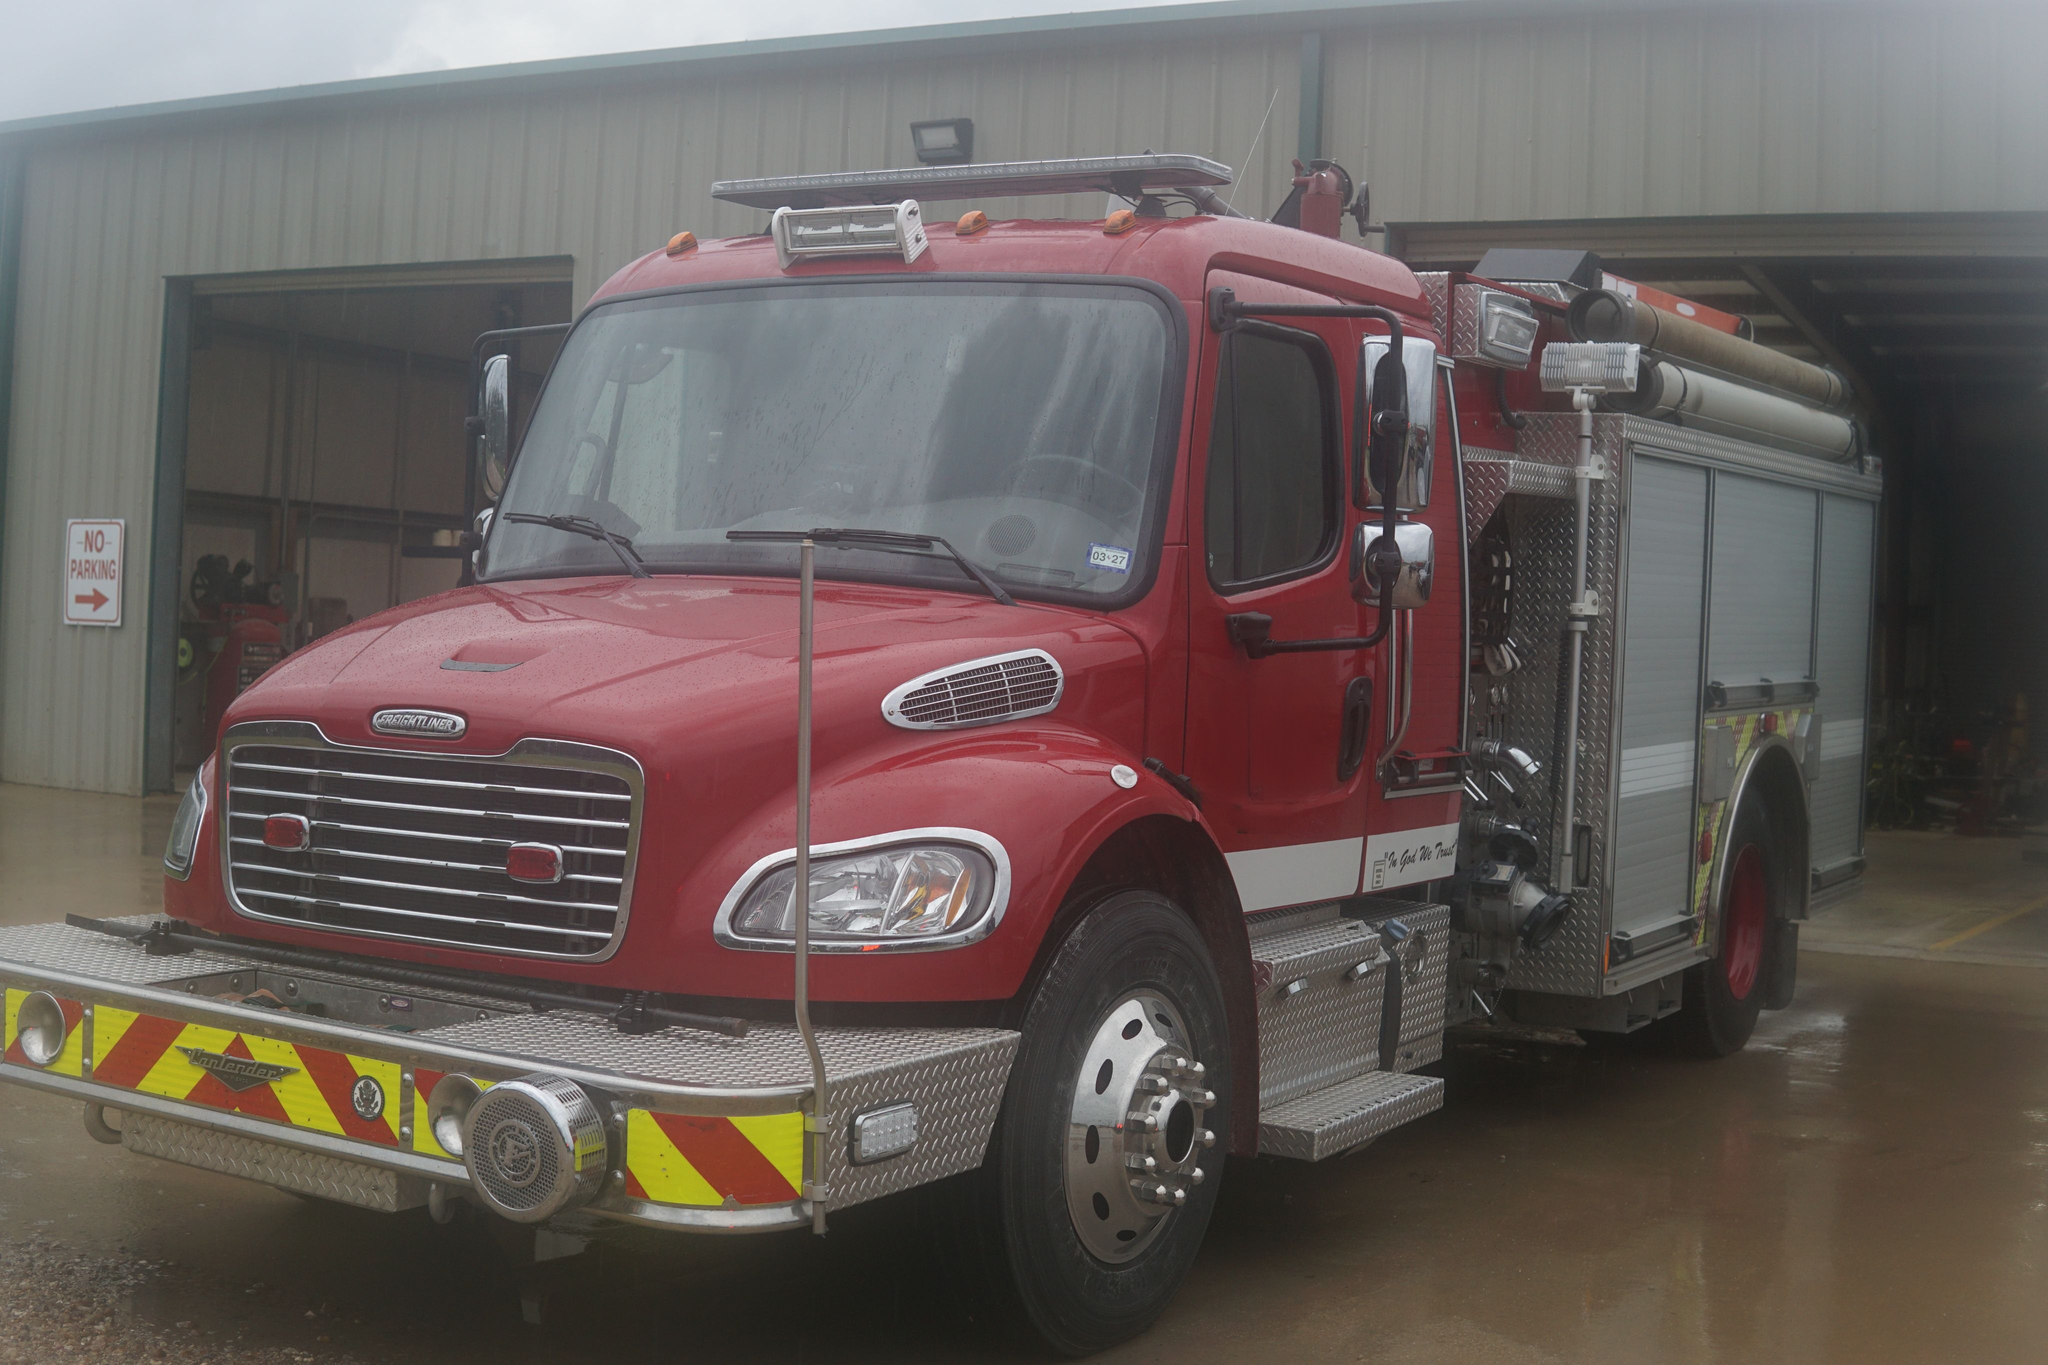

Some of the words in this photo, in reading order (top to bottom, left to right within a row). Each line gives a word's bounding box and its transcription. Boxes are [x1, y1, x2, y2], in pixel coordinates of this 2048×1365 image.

[84, 529, 105, 553] NO
[1092, 551, 1107, 562] 03
[1111, 554, 1126, 565] 27
[70, 559, 116, 580] PARKING
[379, 714, 454, 731] FREIGHTLINER
[1399, 847, 1418, 873] God
[1419, 845, 1433, 862] We
